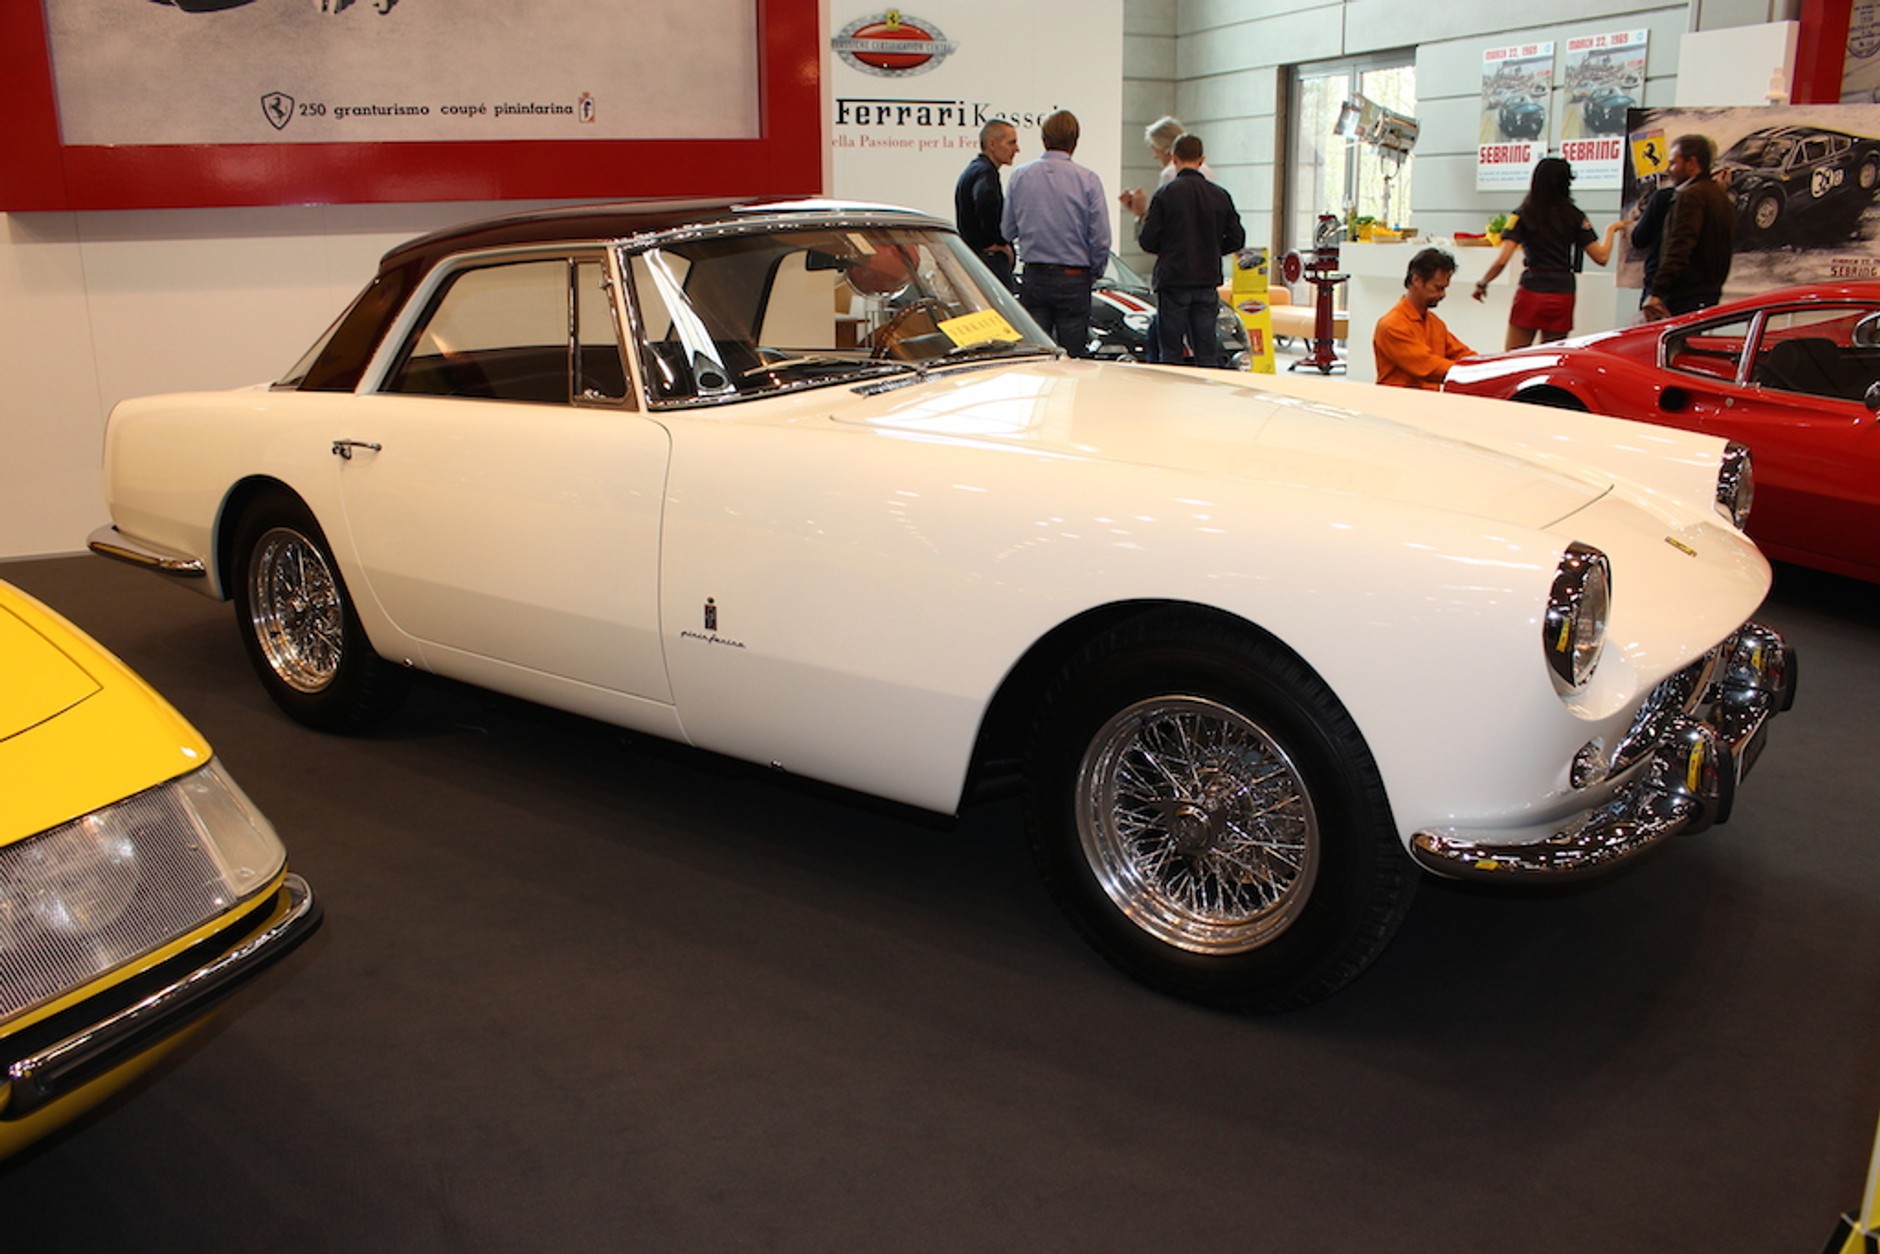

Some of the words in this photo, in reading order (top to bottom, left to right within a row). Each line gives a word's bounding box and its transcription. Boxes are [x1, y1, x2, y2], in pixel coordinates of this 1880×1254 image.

[299, 103, 327, 116] 250
[334, 103, 430, 120] granturismo
[440, 103, 487, 117] coupé
[494, 102, 574, 118] pininfarina
[836, 98, 967, 127] Ferrari
[831, 134, 853, 148] ella
[860, 134, 914, 148] Passione
[919, 140, 939, 151] per
[943, 135, 954, 148] la
[1562, 140, 1620, 161] SEBRING
[1480, 145, 1531, 164] SEBRING
[1831, 265, 1878, 277] SEBRING
[680, 630, 745, 648] pininfarina
